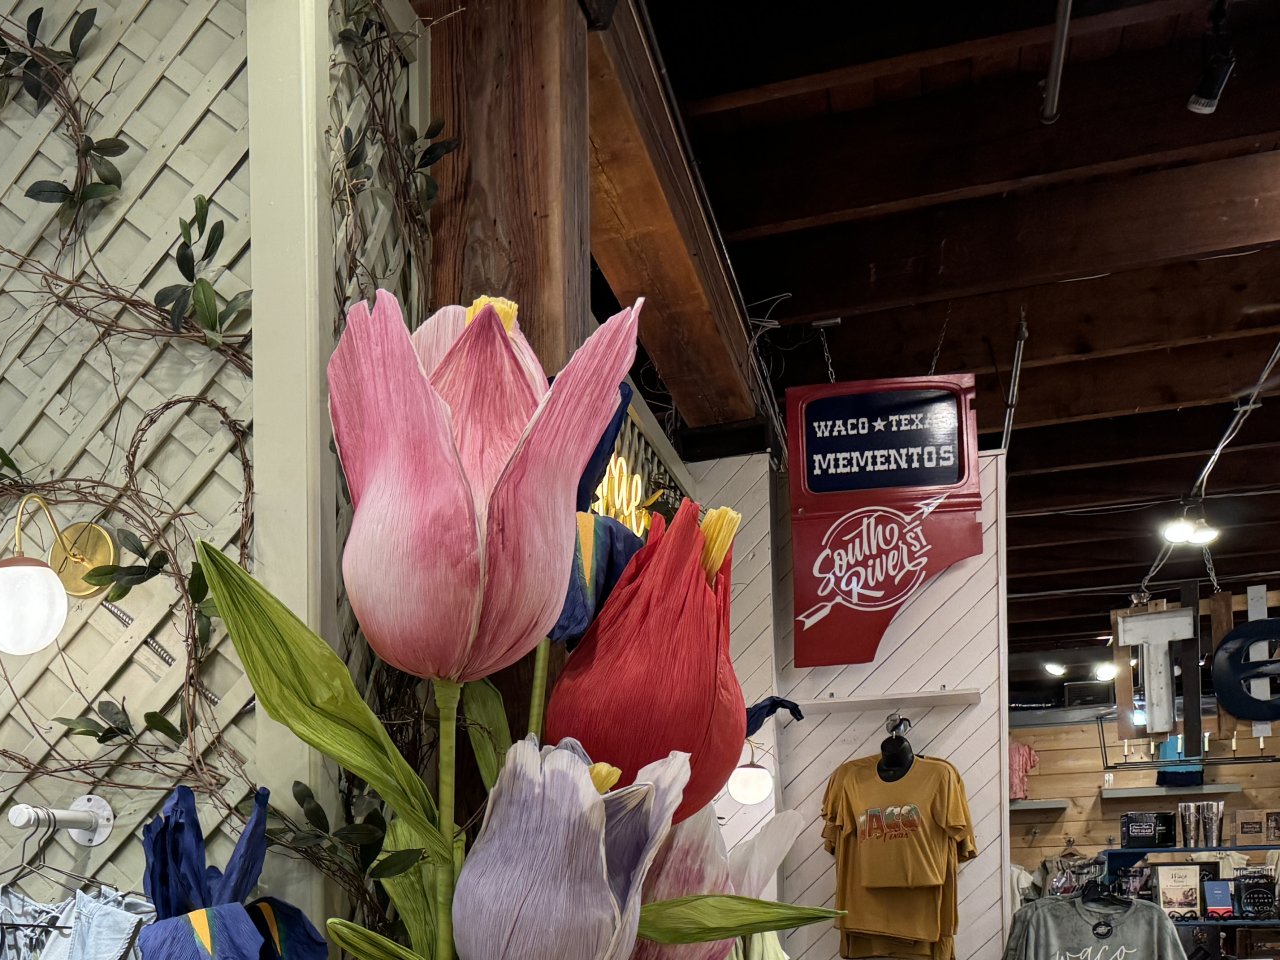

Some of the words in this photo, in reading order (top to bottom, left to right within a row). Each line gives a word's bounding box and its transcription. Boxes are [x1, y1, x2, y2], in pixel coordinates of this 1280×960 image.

[812, 417, 869, 438] WACO
[812, 445, 956, 475] MEMENTOS
[812, 512, 899, 597] South
[840, 541, 927, 604] River
